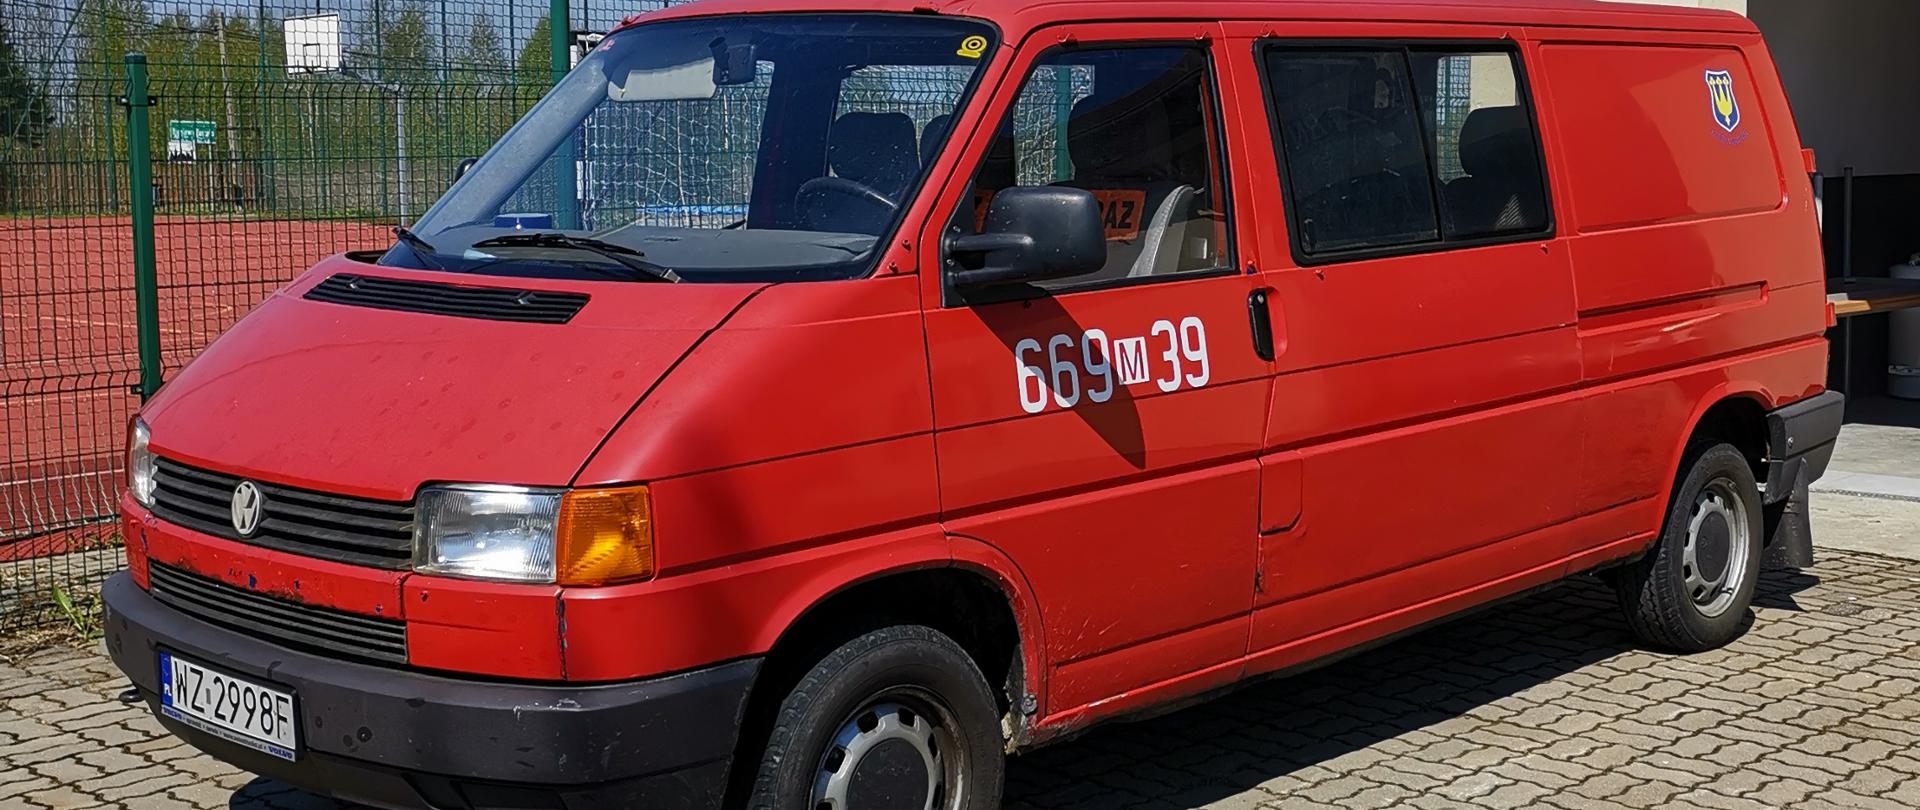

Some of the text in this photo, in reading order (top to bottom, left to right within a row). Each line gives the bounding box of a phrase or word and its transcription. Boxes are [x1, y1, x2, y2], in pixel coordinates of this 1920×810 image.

[1014, 316, 1210, 414] 669 M 39
[174, 661, 205, 713] WZ
[213, 675, 289, 740] 2998F
